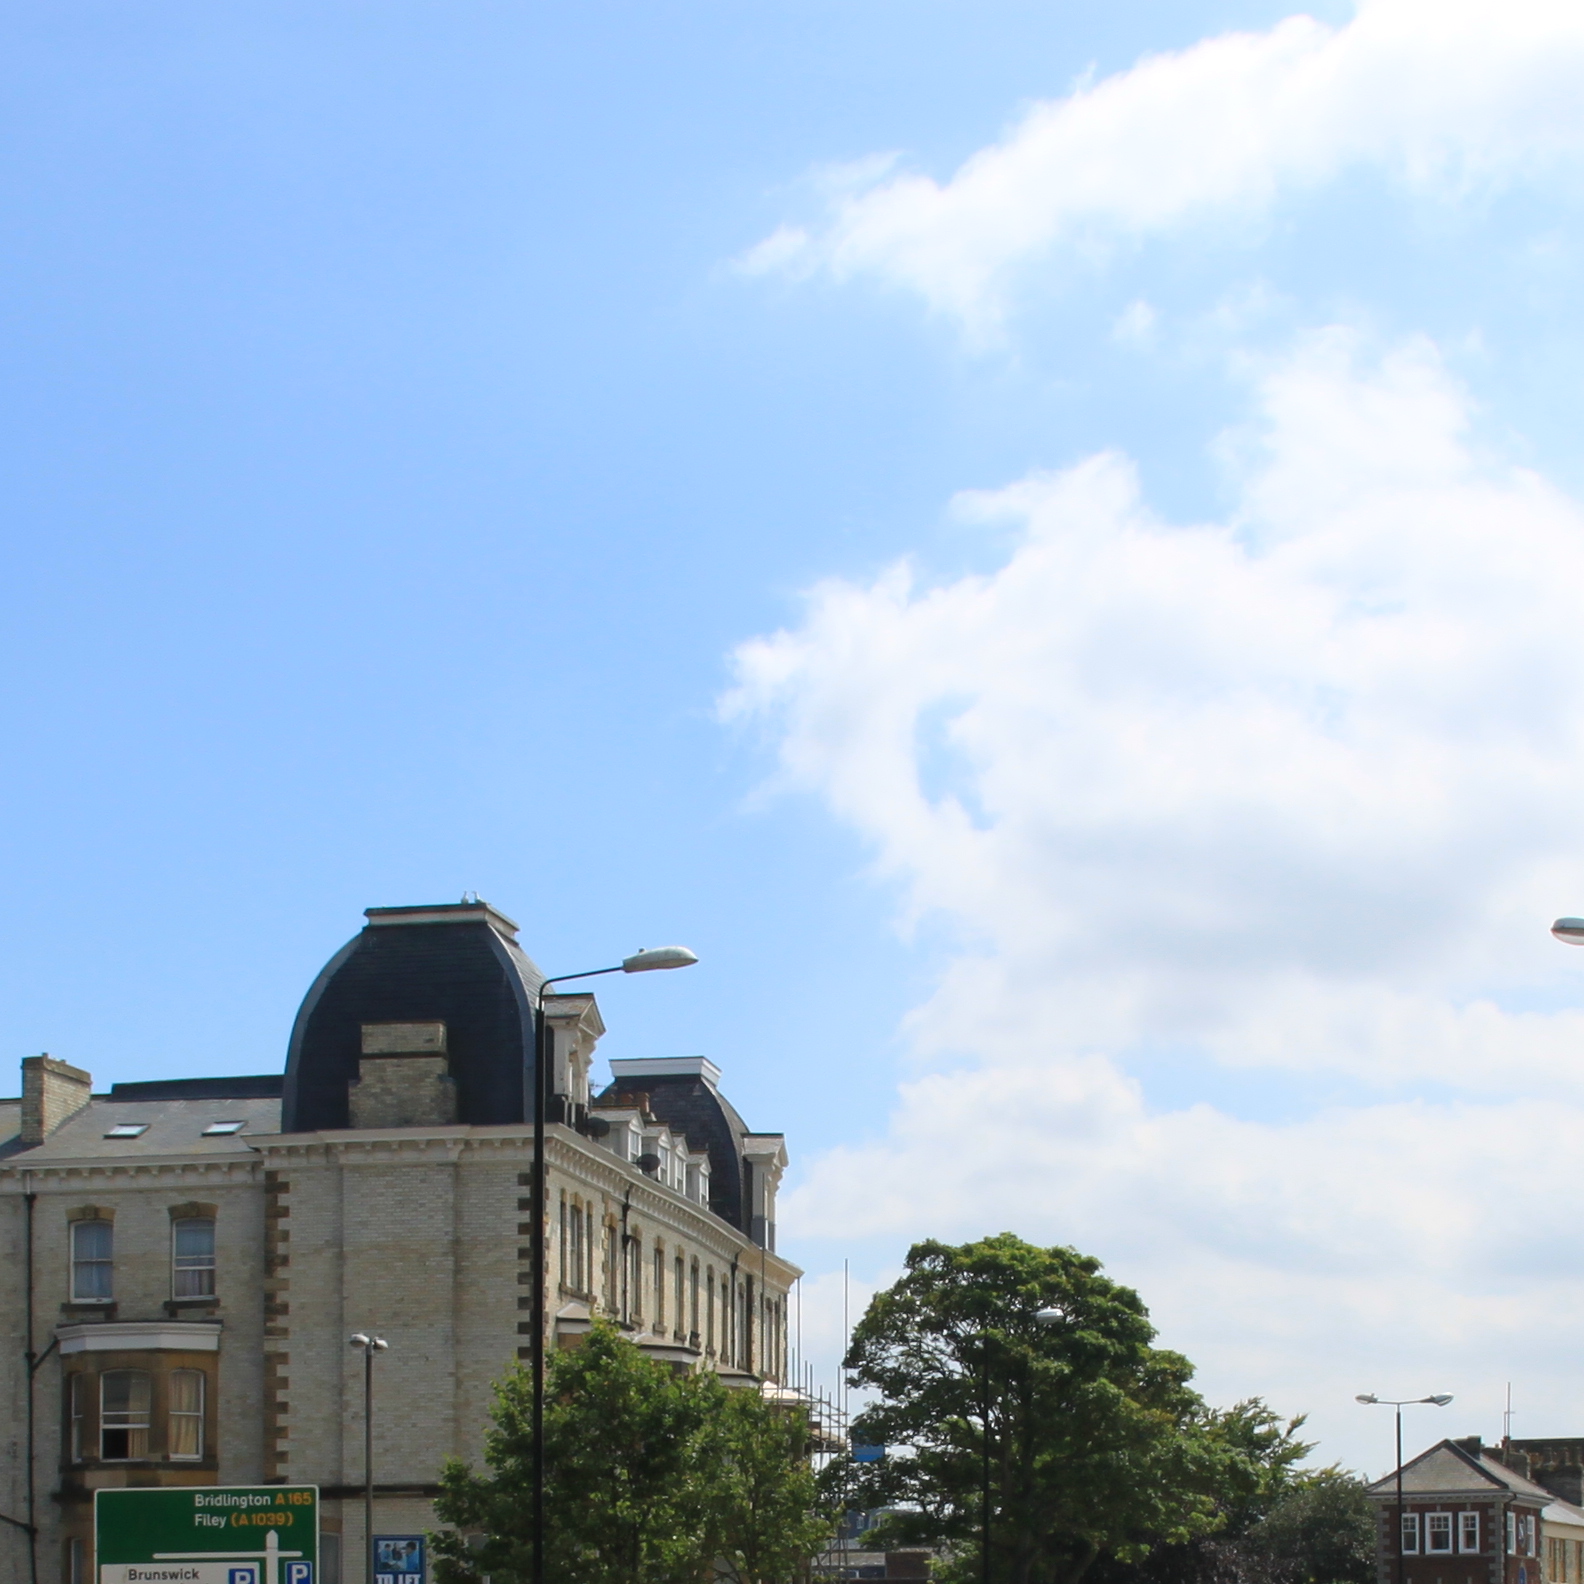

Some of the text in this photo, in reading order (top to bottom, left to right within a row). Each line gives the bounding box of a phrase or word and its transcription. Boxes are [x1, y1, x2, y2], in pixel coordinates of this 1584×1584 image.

[194, 1493, 271, 1508] Bridlington
[194, 1513, 227, 1528] Filey
[128, 1568, 200, 1580] Brunswick
